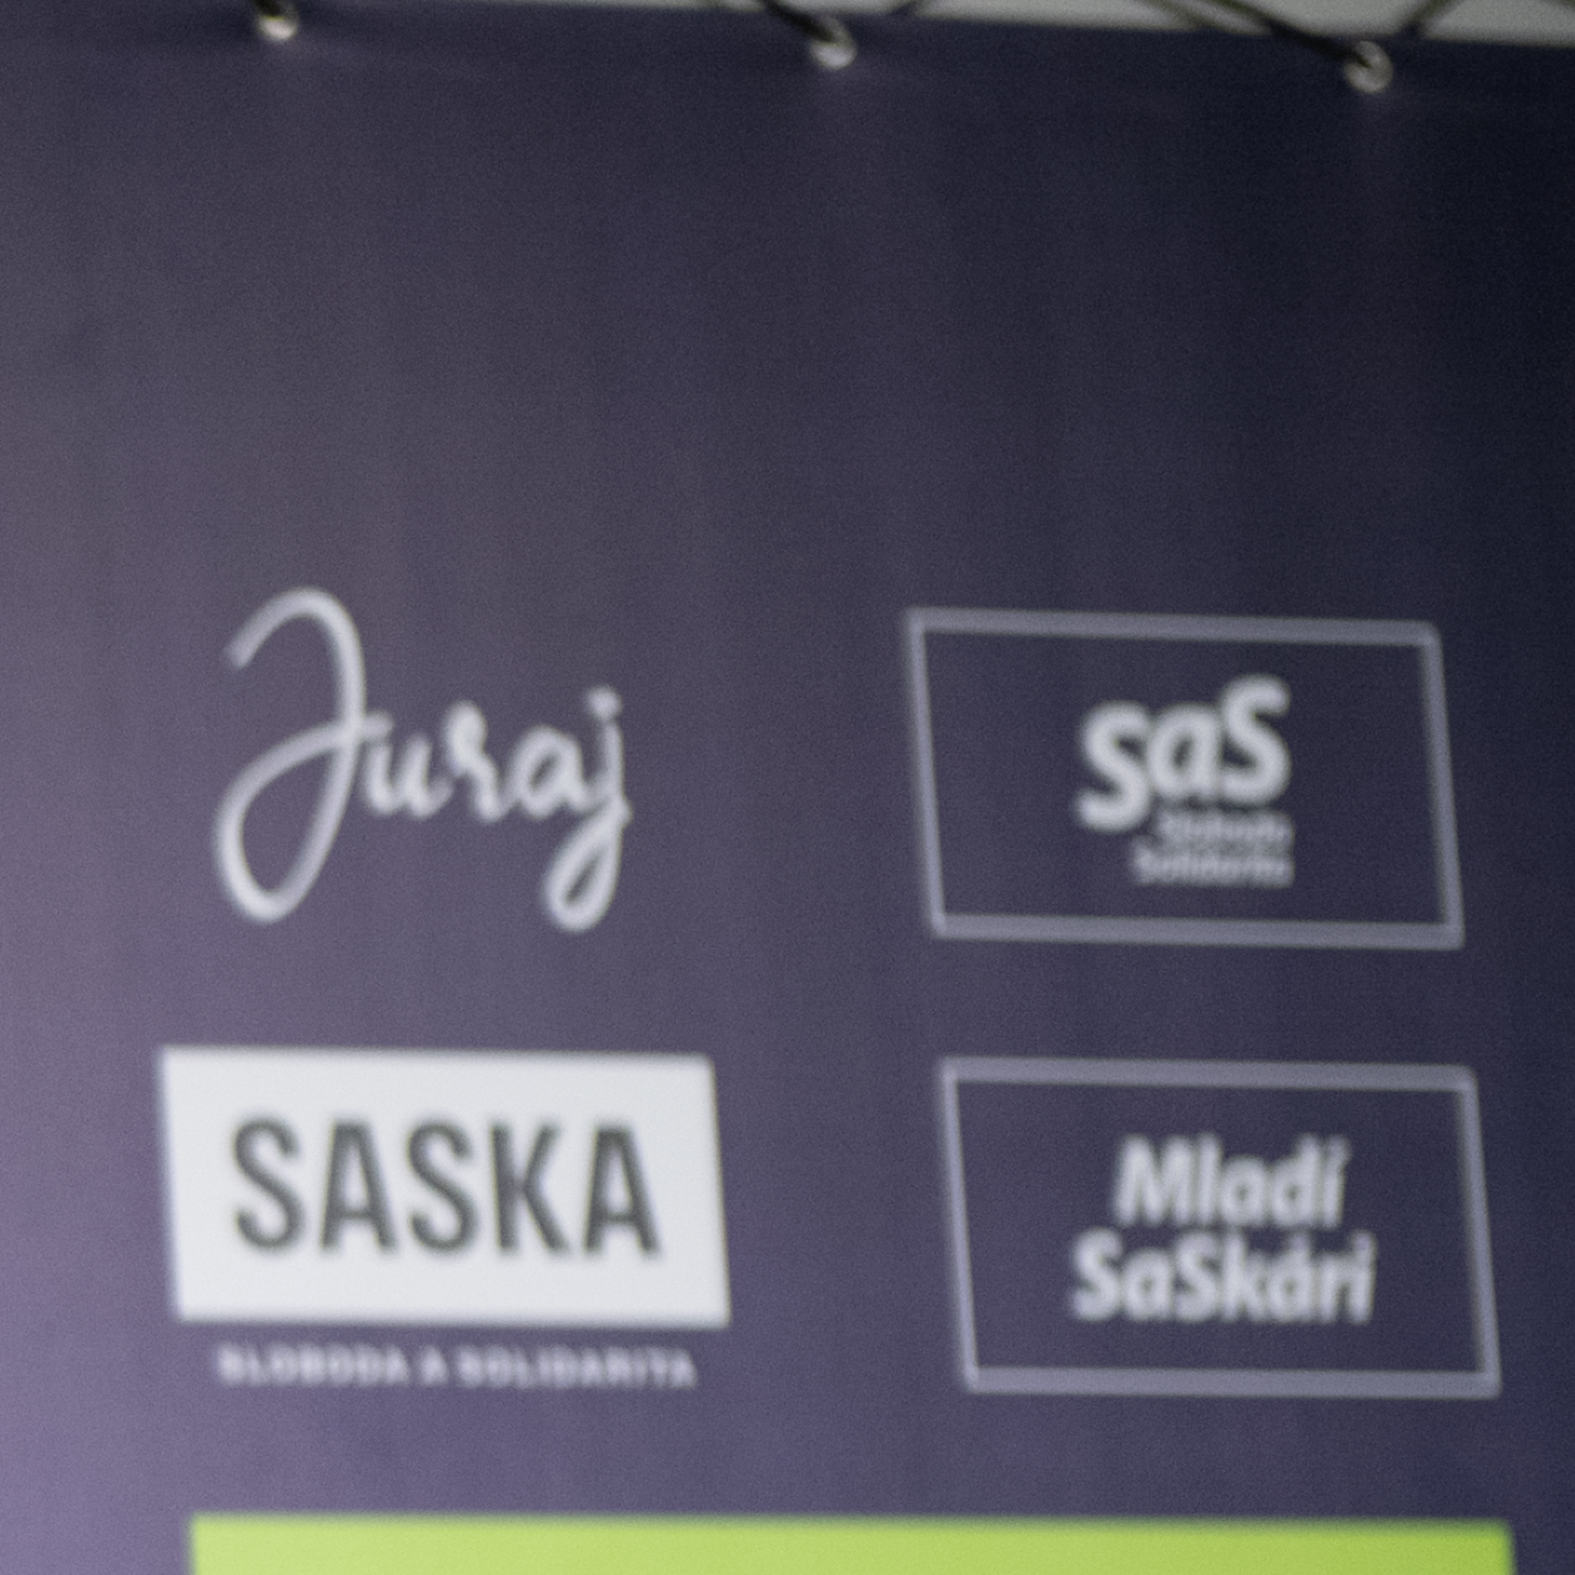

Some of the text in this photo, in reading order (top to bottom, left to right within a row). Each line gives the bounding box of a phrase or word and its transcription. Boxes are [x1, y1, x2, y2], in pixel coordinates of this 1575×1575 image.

[213, 584, 635, 934] Juraj
[231, 1116, 661, 1258] SASKA
[1115, 1132, 1349, 1230] Mladí
[215, 1344, 699, 1392] SLOBODA A SOLIDARITA
